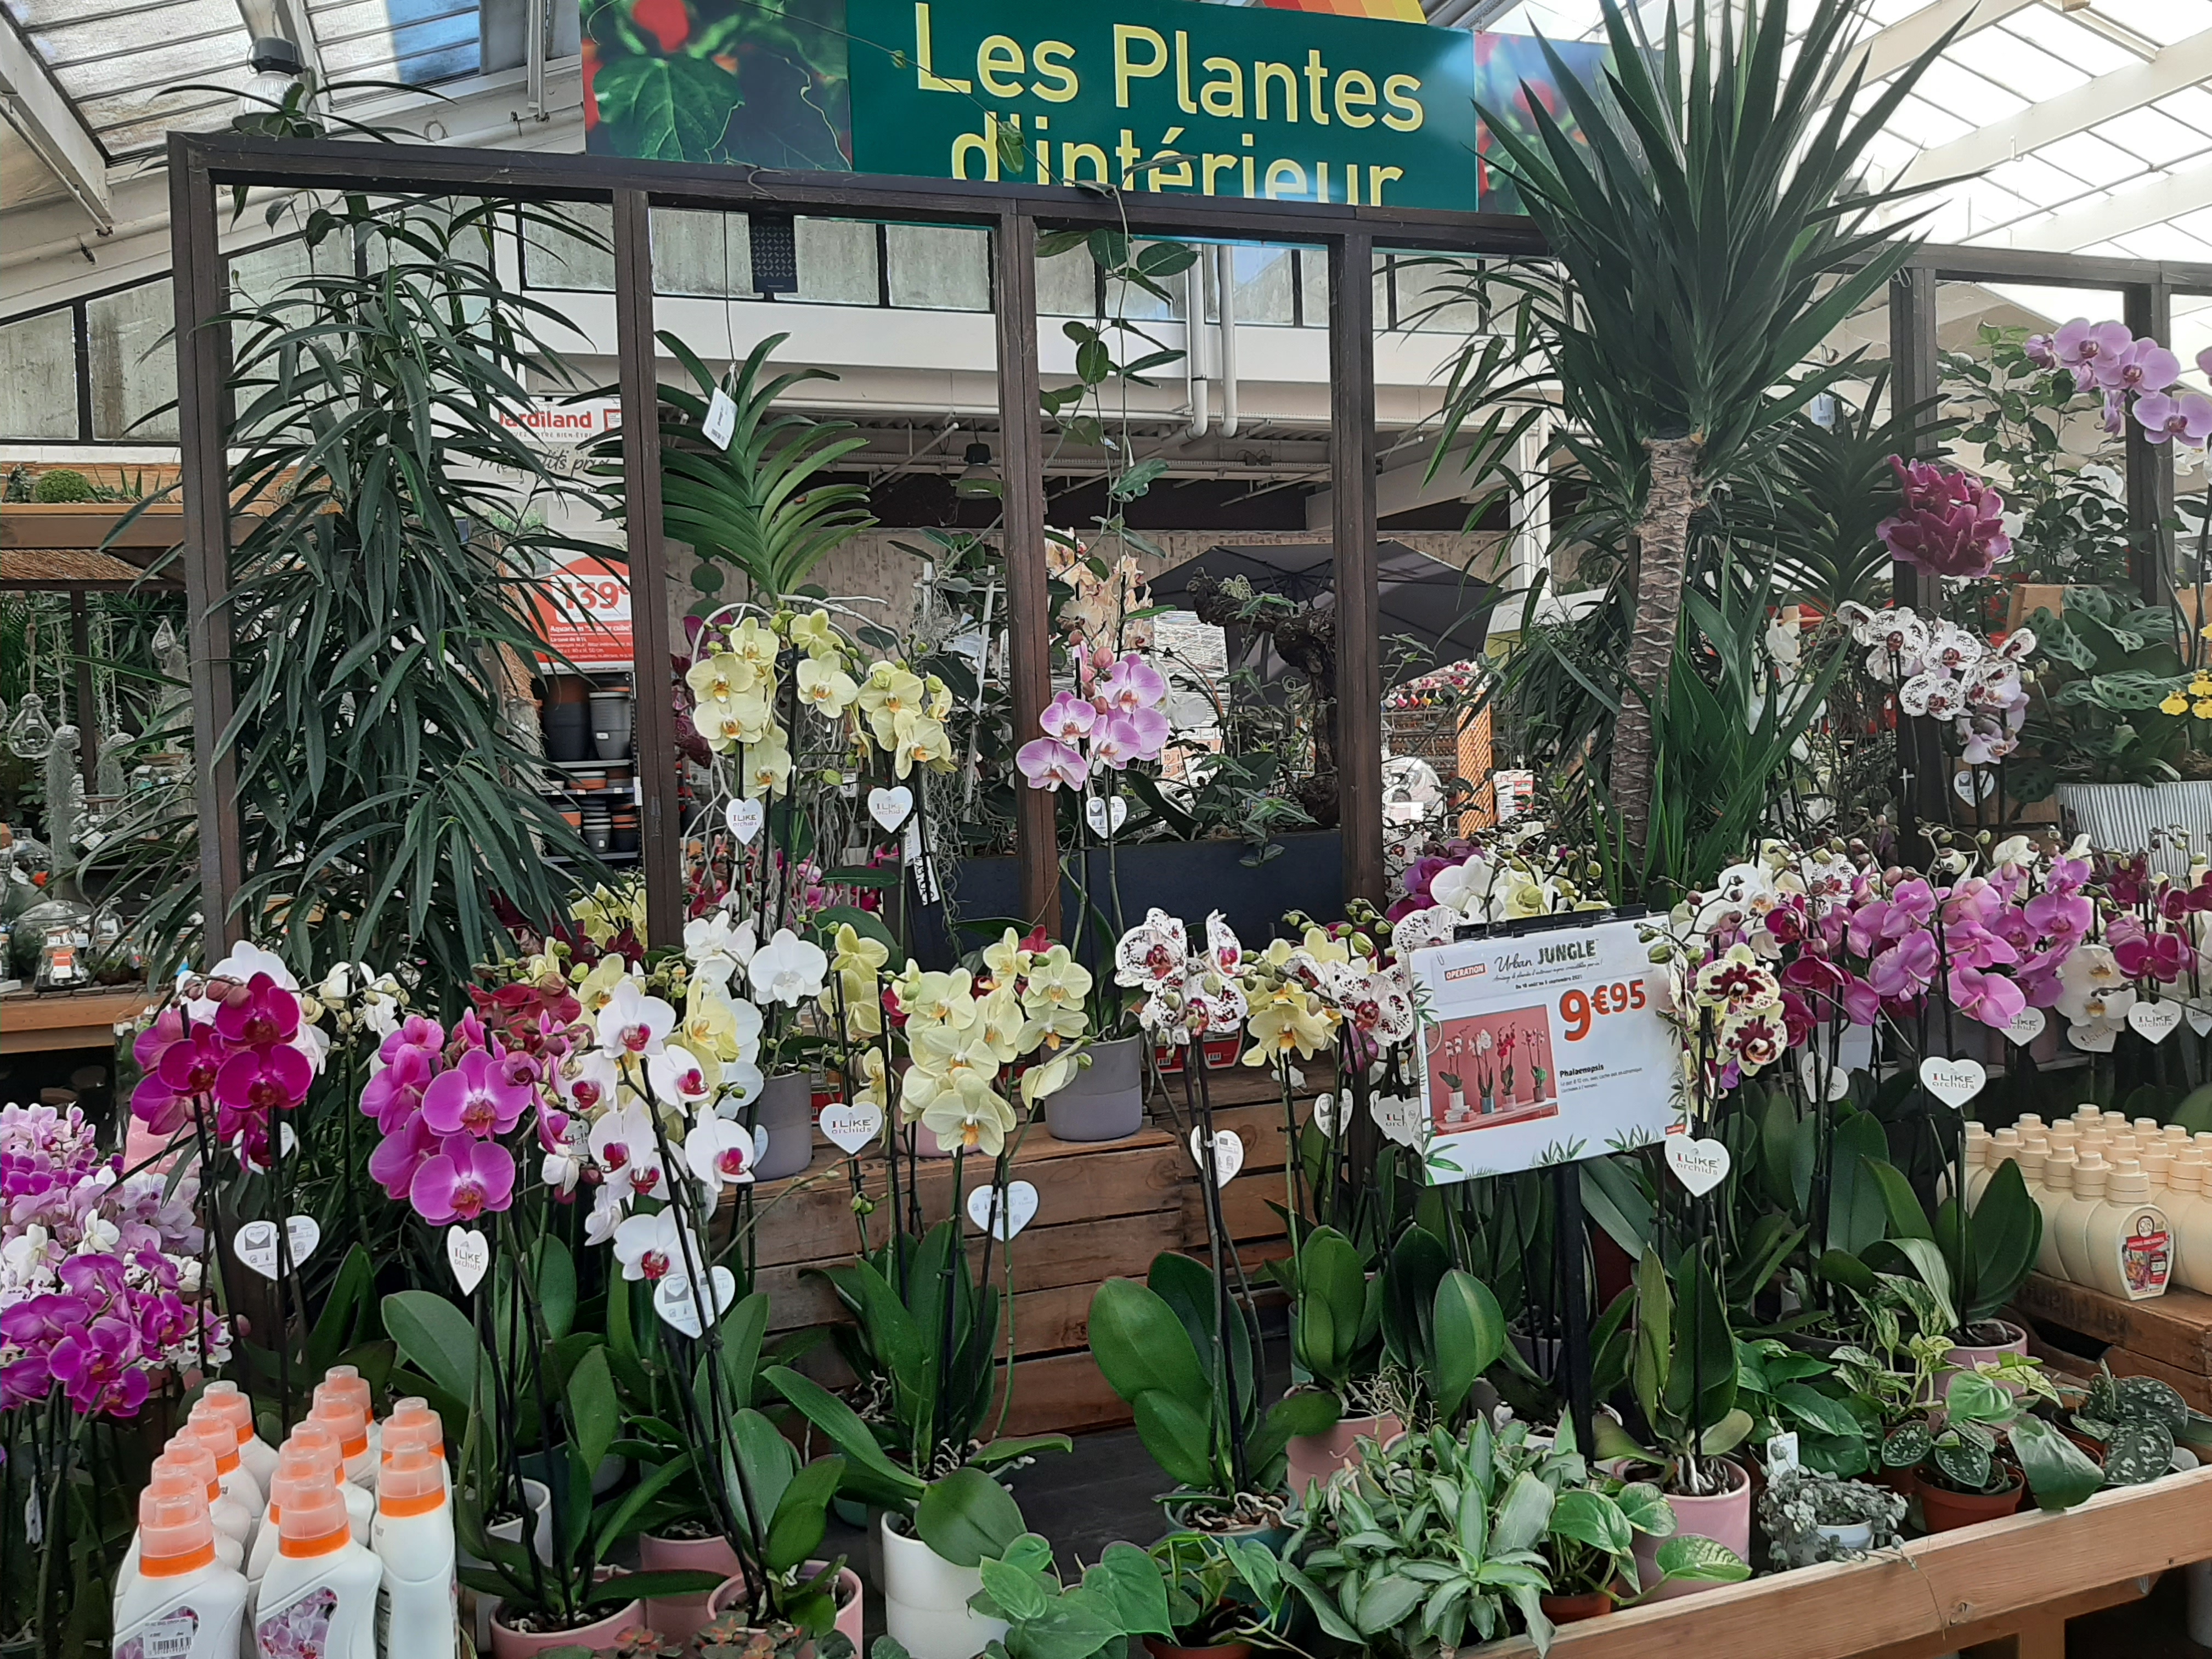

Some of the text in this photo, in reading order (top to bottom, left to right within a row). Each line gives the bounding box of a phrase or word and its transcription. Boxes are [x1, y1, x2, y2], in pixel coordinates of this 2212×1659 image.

[915, 2, 1425, 131] Les Plantes
[1494, 953, 1533, 973] Urban
[1537, 939, 1596, 965] JUNGLE
[1559, 979, 1646, 1042] 9€95
[1560, 1063, 1604, 1078] Phalaenopsis
[1940, 1073, 1974, 1083] LIKE
[840, 1119, 871, 1127] LIKE
[1676, 1163, 1718, 1175] orchids
[1685, 1154, 1718, 1169] LIKE
[459, 1249, 481, 1263] LIKE
